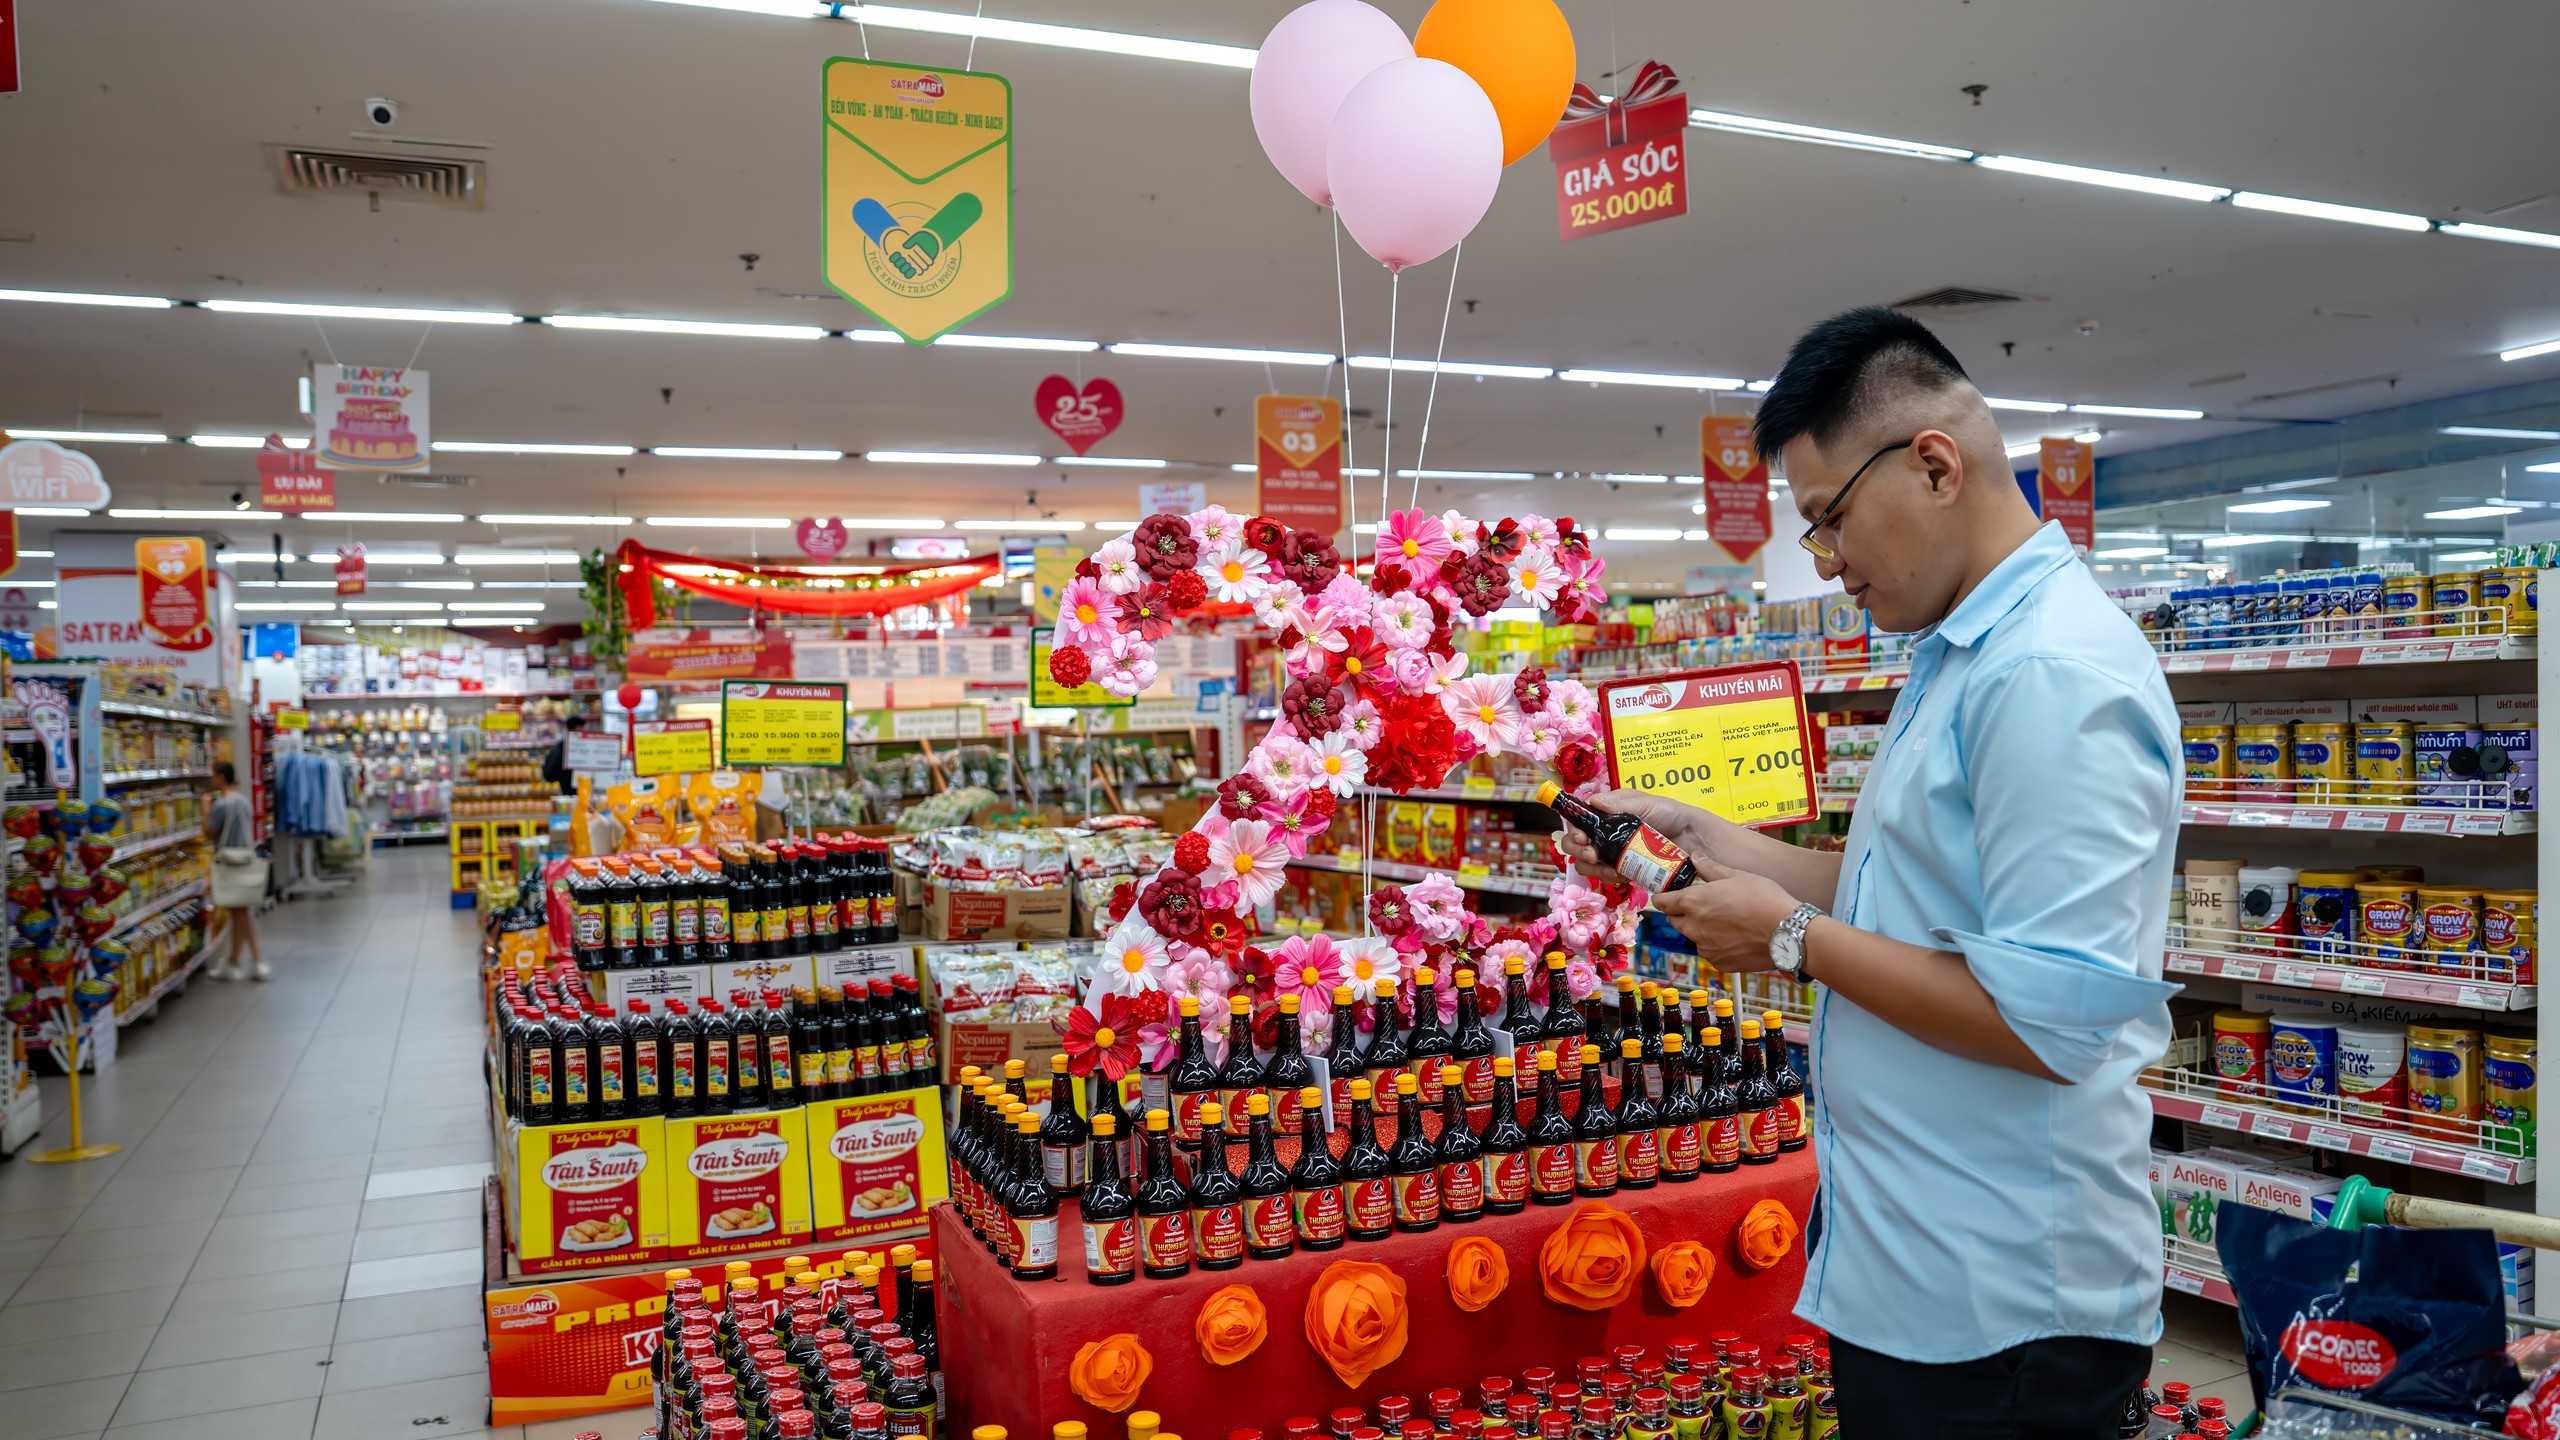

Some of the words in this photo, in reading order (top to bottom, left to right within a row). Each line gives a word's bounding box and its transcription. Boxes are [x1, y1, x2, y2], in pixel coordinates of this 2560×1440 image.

[873, 104, 883, 118] AN
[965, 113, 983, 129] MINH
[1564, 158, 1615, 197] GIÁ
[1622, 141, 1679, 182] SỐC
[1571, 182, 1675, 228] 25.000đ
[868, 251, 881, 273] TICK
[880, 272, 905, 292] XANH
[908, 283, 938, 293] TRÁCH
[342, 368, 405, 382] HAPPY
[336, 382, 412, 398] BIRTHDAY
[1282, 432, 1317, 454] 03
[1721, 448, 1750, 467] 02
[8, 461, 44, 476] Free
[2055, 467, 2077, 484] 01
[10, 477, 68, 499] WiFi
[157, 560, 186, 576] 09
[776, 686, 812, 698] KHUYẾN
[814, 688, 831, 698] MÃI
[1699, 677, 1756, 699] KHUYẾN
[1757, 677, 1783, 692] MÃI
[2250, 708, 2263, 716] UHT
[2264, 707, 2294, 716] sterilized
[2296, 707, 2315, 715] whole
[2317, 706, 2332, 715] milk
[2366, 704, 2380, 713] UHT
[2382, 702, 2415, 713] sterilized
[2417, 702, 2439, 713] whole
[2441, 702, 2459, 712] milk
[2496, 700, 2512, 709] UHT
[1620, 741, 1639, 750] NAM
[1621, 749, 1642, 758] MEN
[1622, 755, 1647, 764] CHAI
[1649, 751, 1679, 761] 280ML
[1728, 748, 1804, 778] 7.000
[1625, 765, 1711, 790] 10.000
[1700, 787, 1715, 795] VND
[2274, 782, 2282, 791] 2
[1738, 801, 1769, 812] 8.000
[955, 897, 1003, 910] Neptune
[2368, 907, 2405, 920] GROW
[2428, 912, 2467, 926] GROW
[2373, 921, 2400, 930] PLUS
[2433, 926, 2462, 936] PLUS
[957, 1033, 1007, 1047] Neptune
[2273, 1039, 2310, 1054] Grow
[2217, 1042, 2248, 1055] Grow
[864, 1103, 893, 1118] Cooking
[894, 1101, 909, 1110] Oil
[725, 1122, 756, 1137] Cooking
[758, 1120, 773, 1130] Oil
[581, 1131, 613, 1147] Cooking
[615, 1129, 631, 1139] Oil
[836, 1134, 869, 1153] Tân
[871, 1128, 917, 1149] Sanh
[695, 1152, 728, 1171] Tân
[731, 1147, 780, 1167] Sanh
[549, 1162, 585, 1182] Tân
[587, 1158, 639, 1178] Sanh
[2173, 1165, 2227, 1191] Anlene
[2245, 1181, 2302, 1207] Anlene
[2244, 1197, 2268, 1208] GOLD
[874, 1221, 890, 1231] GIA
[730, 1242, 747, 1251] GIA
[585, 1255, 602, 1265] GIA
[492, 1298, 556, 1318] SATRAMART
[2343, 1362, 2382, 1377] FOODS
